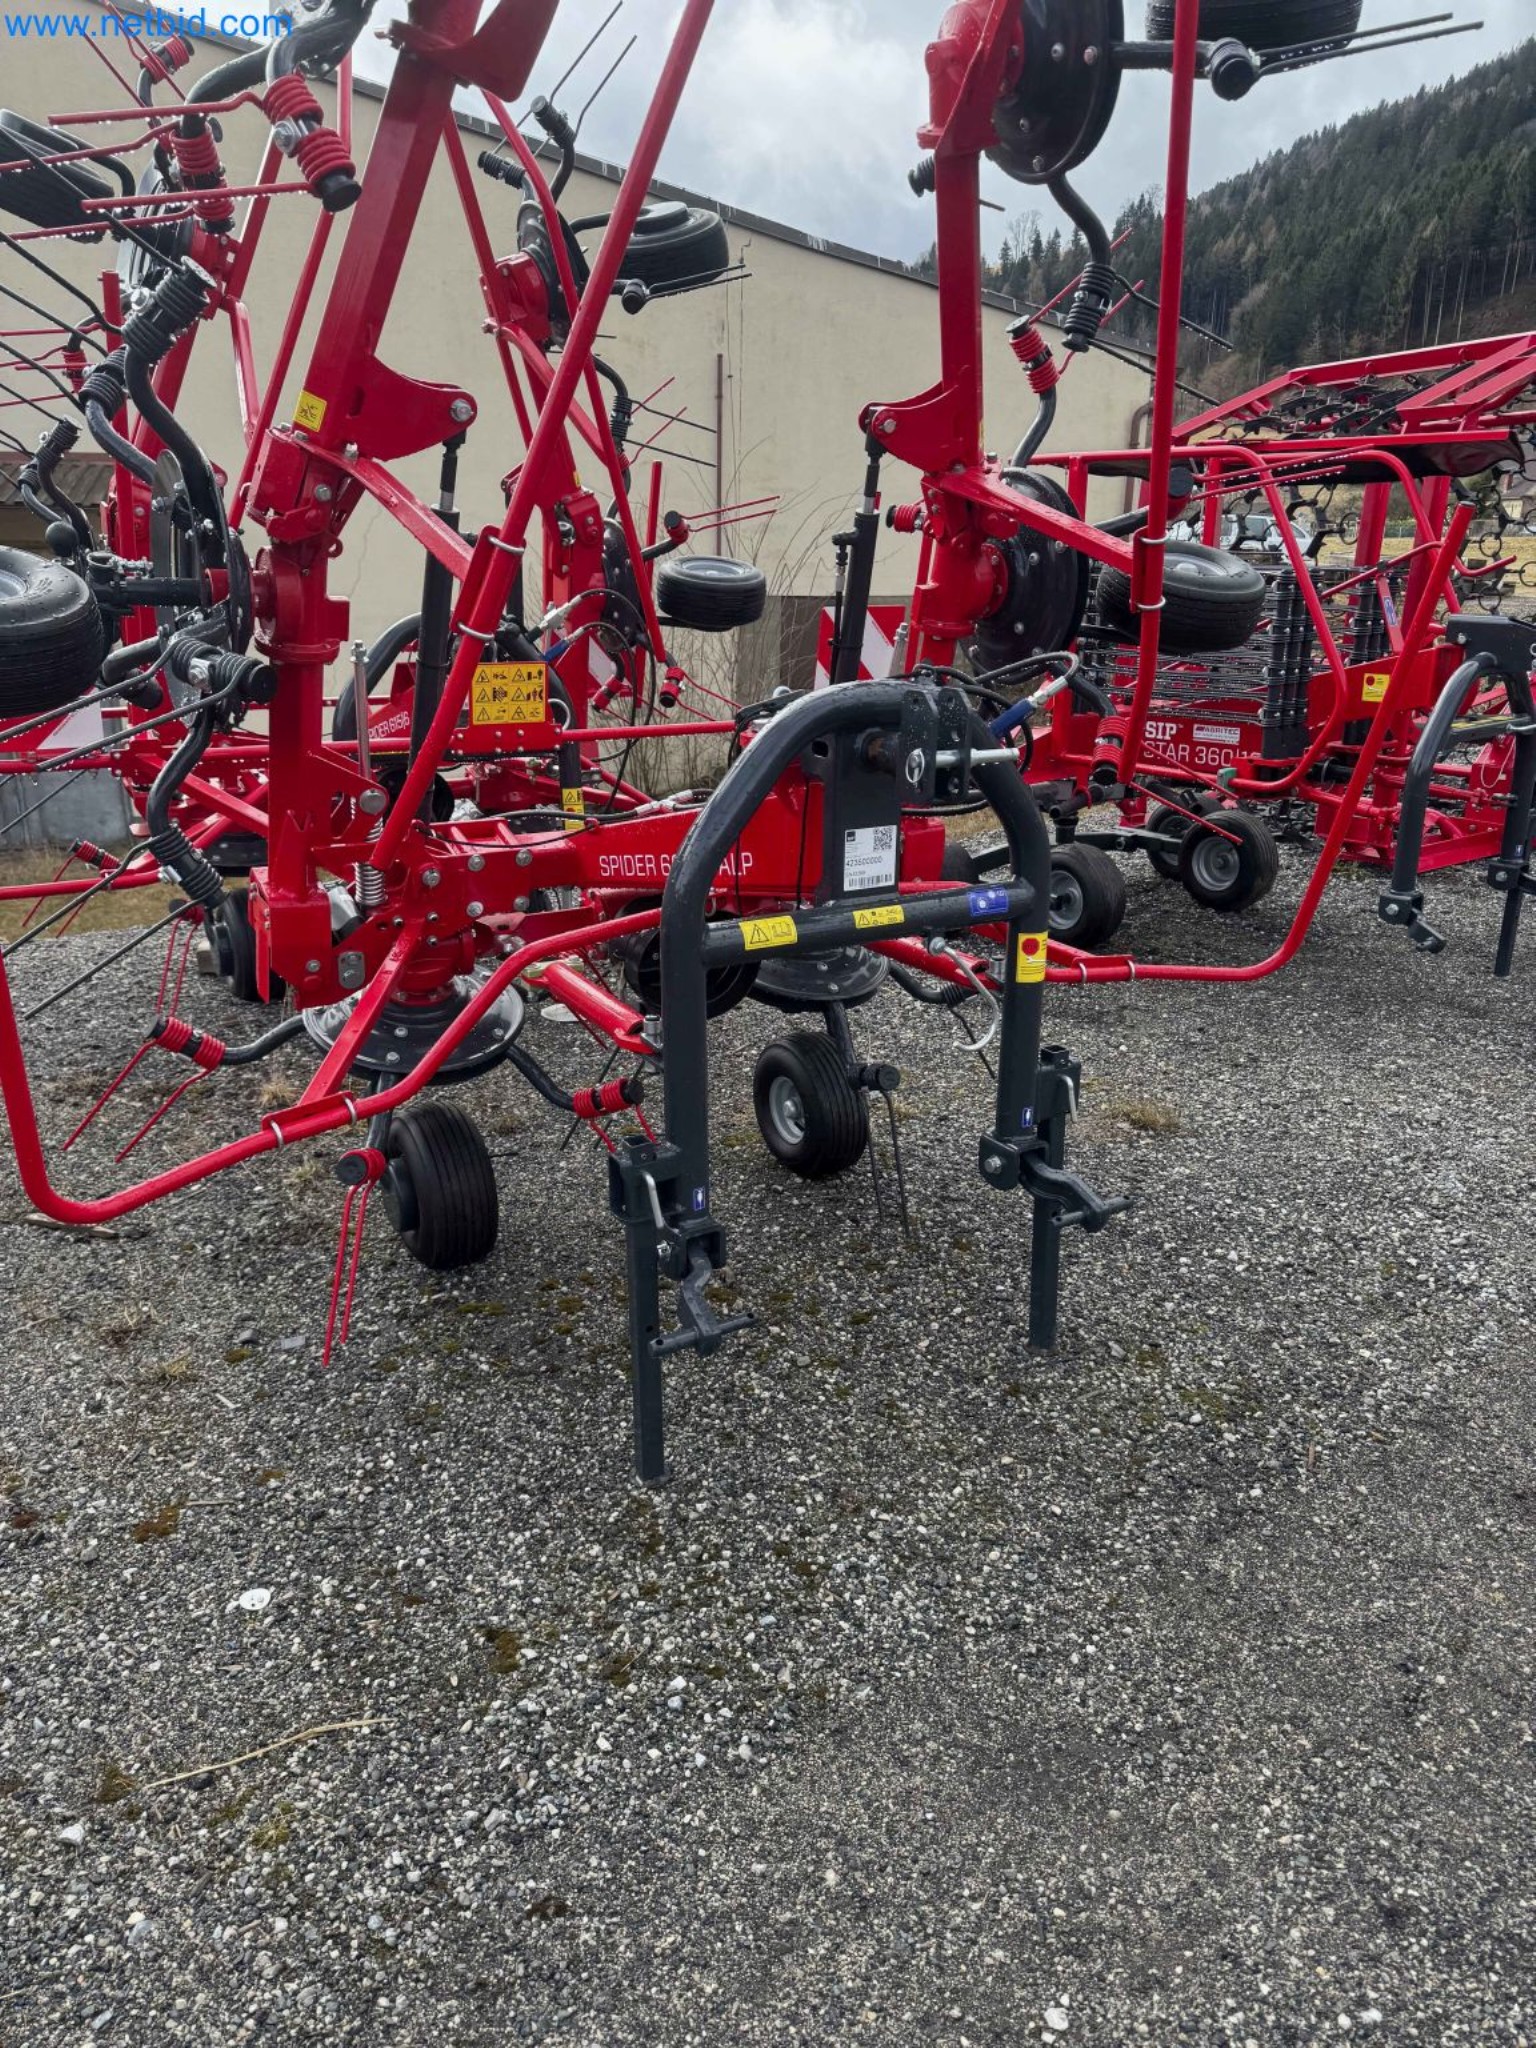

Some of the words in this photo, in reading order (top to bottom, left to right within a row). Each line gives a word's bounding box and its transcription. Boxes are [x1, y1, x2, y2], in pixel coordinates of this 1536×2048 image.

[1144, 720, 1177, 740] SIP
[1143, 740, 1190, 762] STAR
[599, 854, 657, 877] SPIDER
[719, 852, 753, 876] ALP
